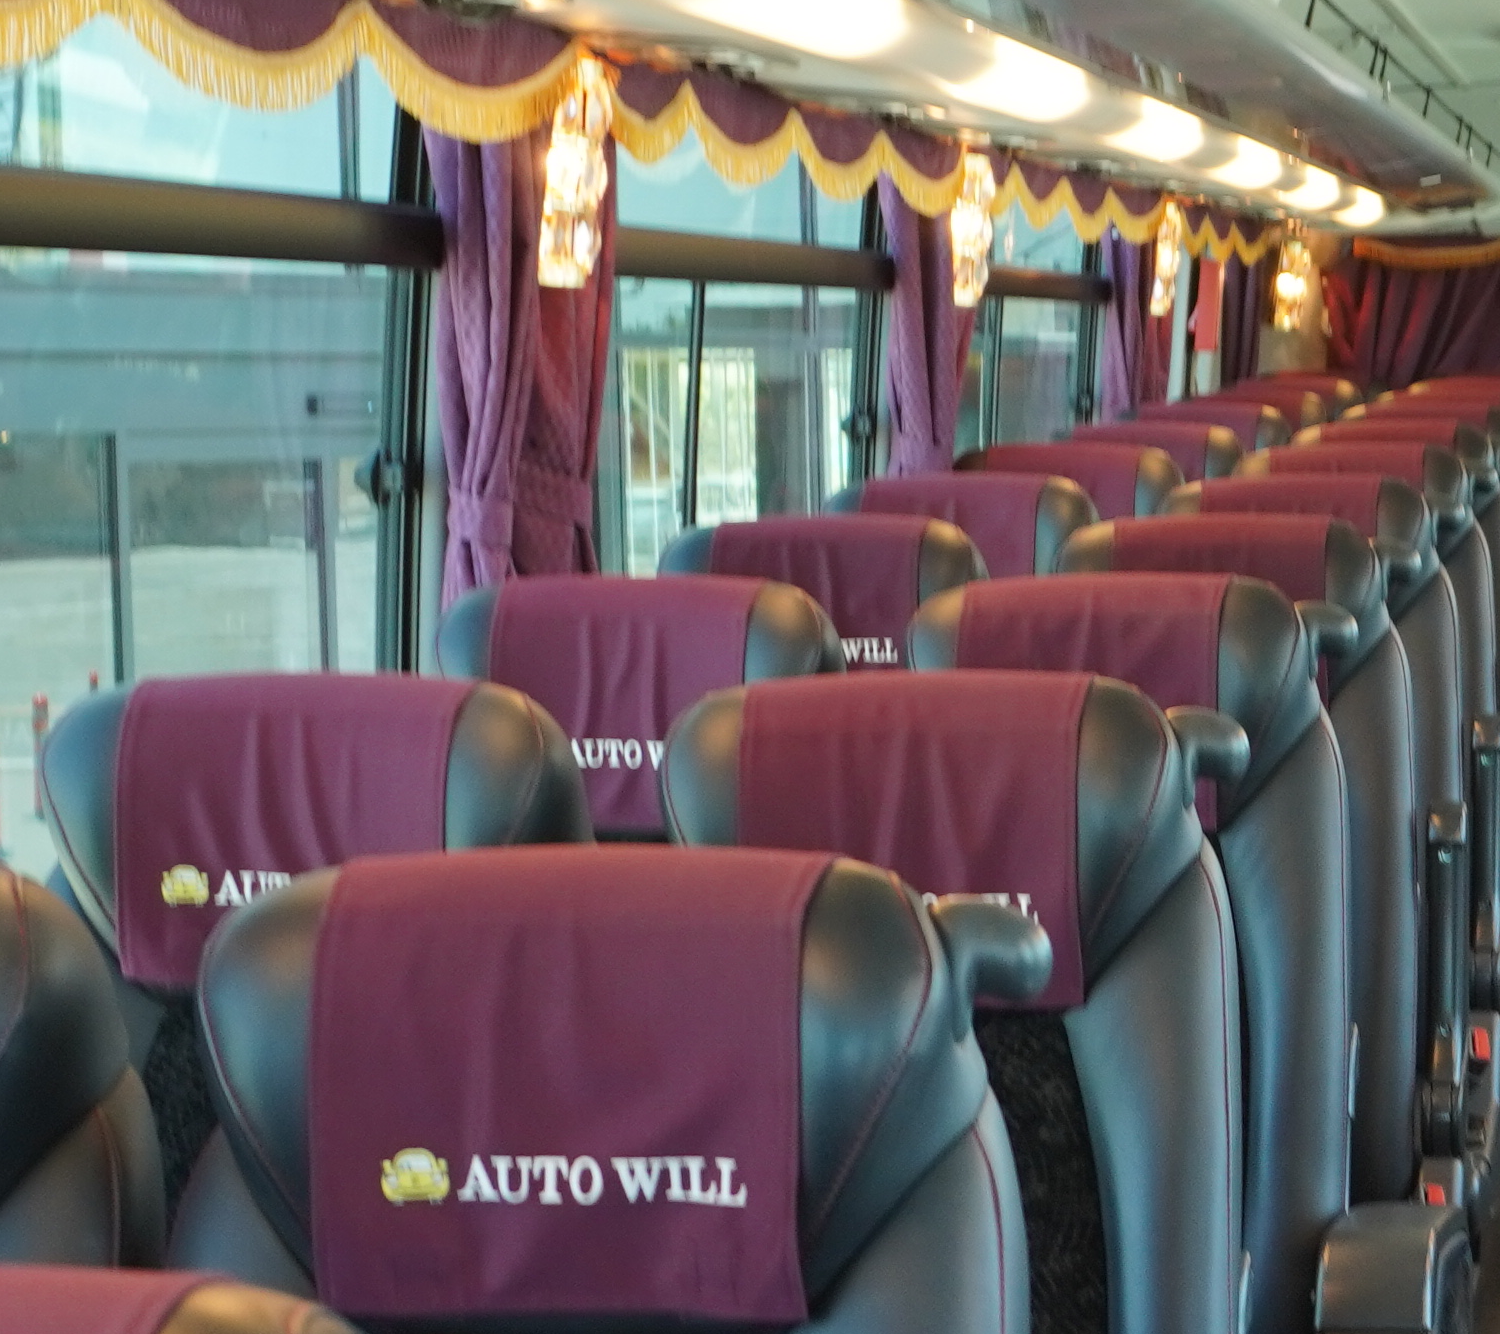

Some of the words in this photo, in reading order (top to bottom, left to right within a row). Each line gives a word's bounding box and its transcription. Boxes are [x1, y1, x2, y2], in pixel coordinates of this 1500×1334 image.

[840, 637, 898, 664] WILL
[457, 1153, 604, 1206] AUTO
[610, 1155, 748, 1208] WILL
